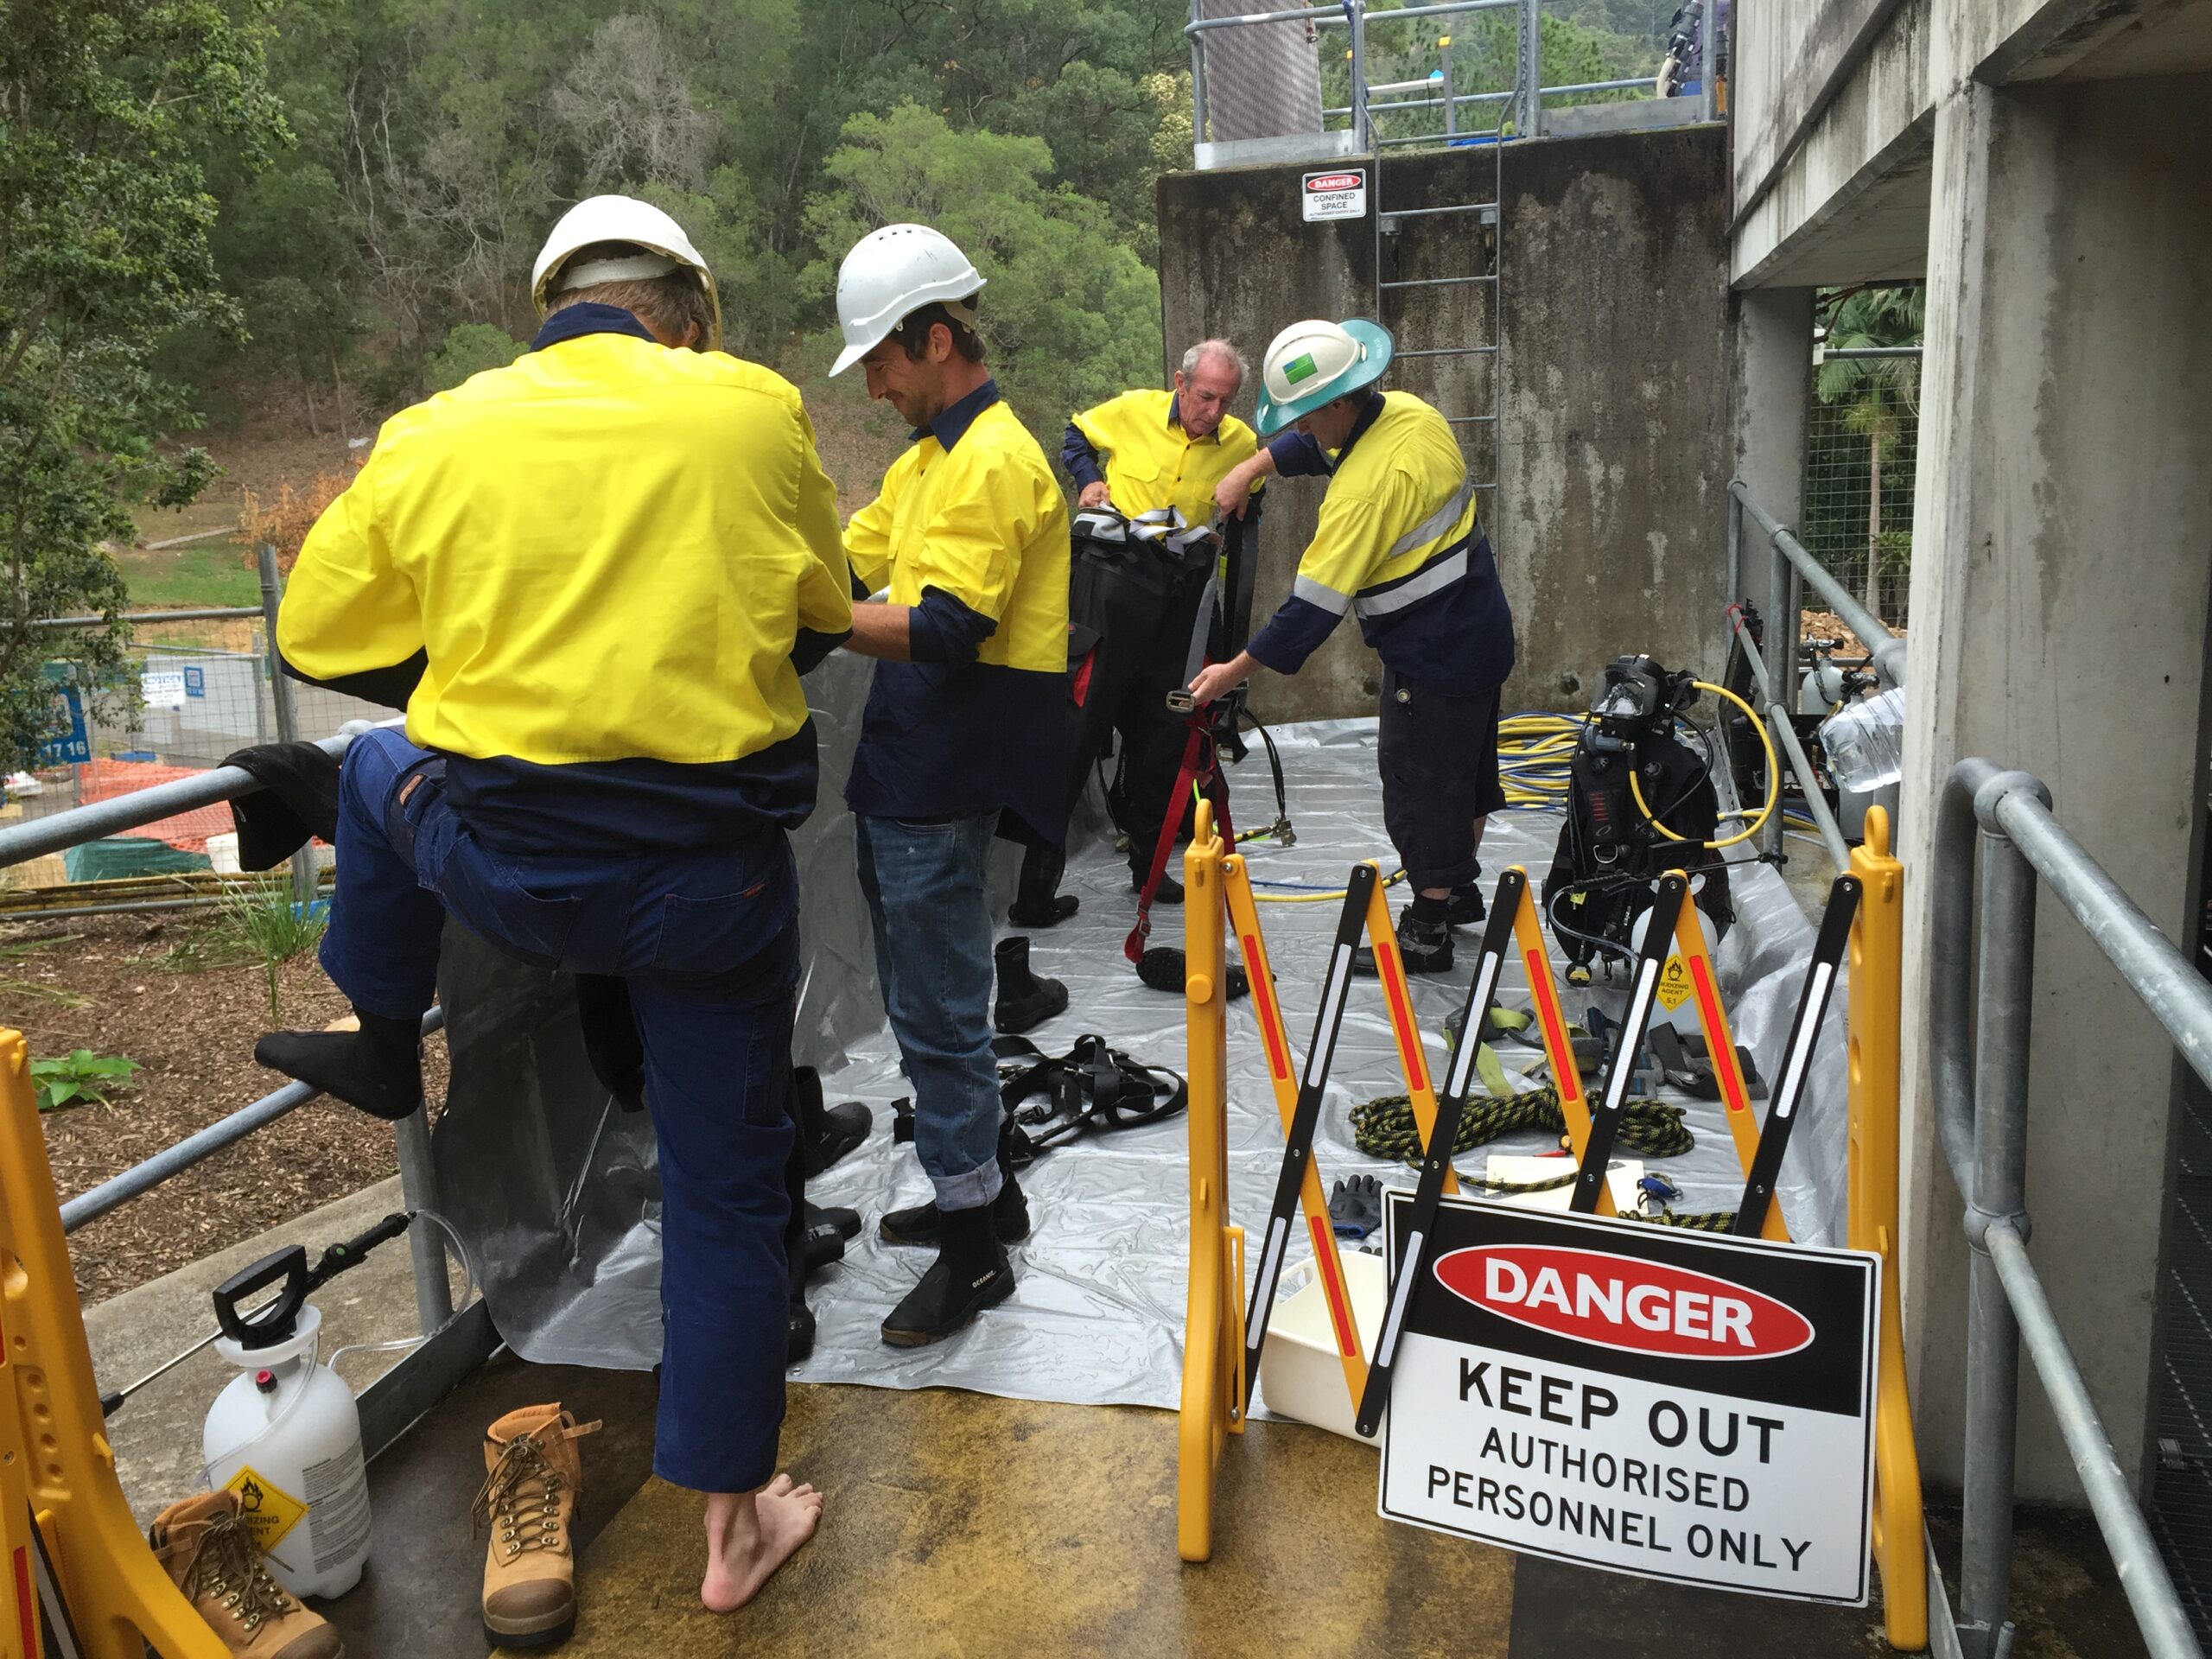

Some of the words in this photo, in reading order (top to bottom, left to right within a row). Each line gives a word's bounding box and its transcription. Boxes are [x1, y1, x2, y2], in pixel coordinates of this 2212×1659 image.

[1313, 192, 1355, 202] CONFINED
[1314, 177, 1354, 188] DANGER
[1321, 201, 1348, 210] SPACE
[1484, 1256, 1757, 1348] DANGER
[1459, 1357, 1619, 1431] KEEP
[1648, 1399, 1785, 1465] OUT
[1479, 1427, 1750, 1512] AUTHORISED
[250, 1527, 271, 1535] ENT
[1427, 1465, 1672, 1553] PERSONNEL
[1687, 1524, 1813, 1572] ONLY
